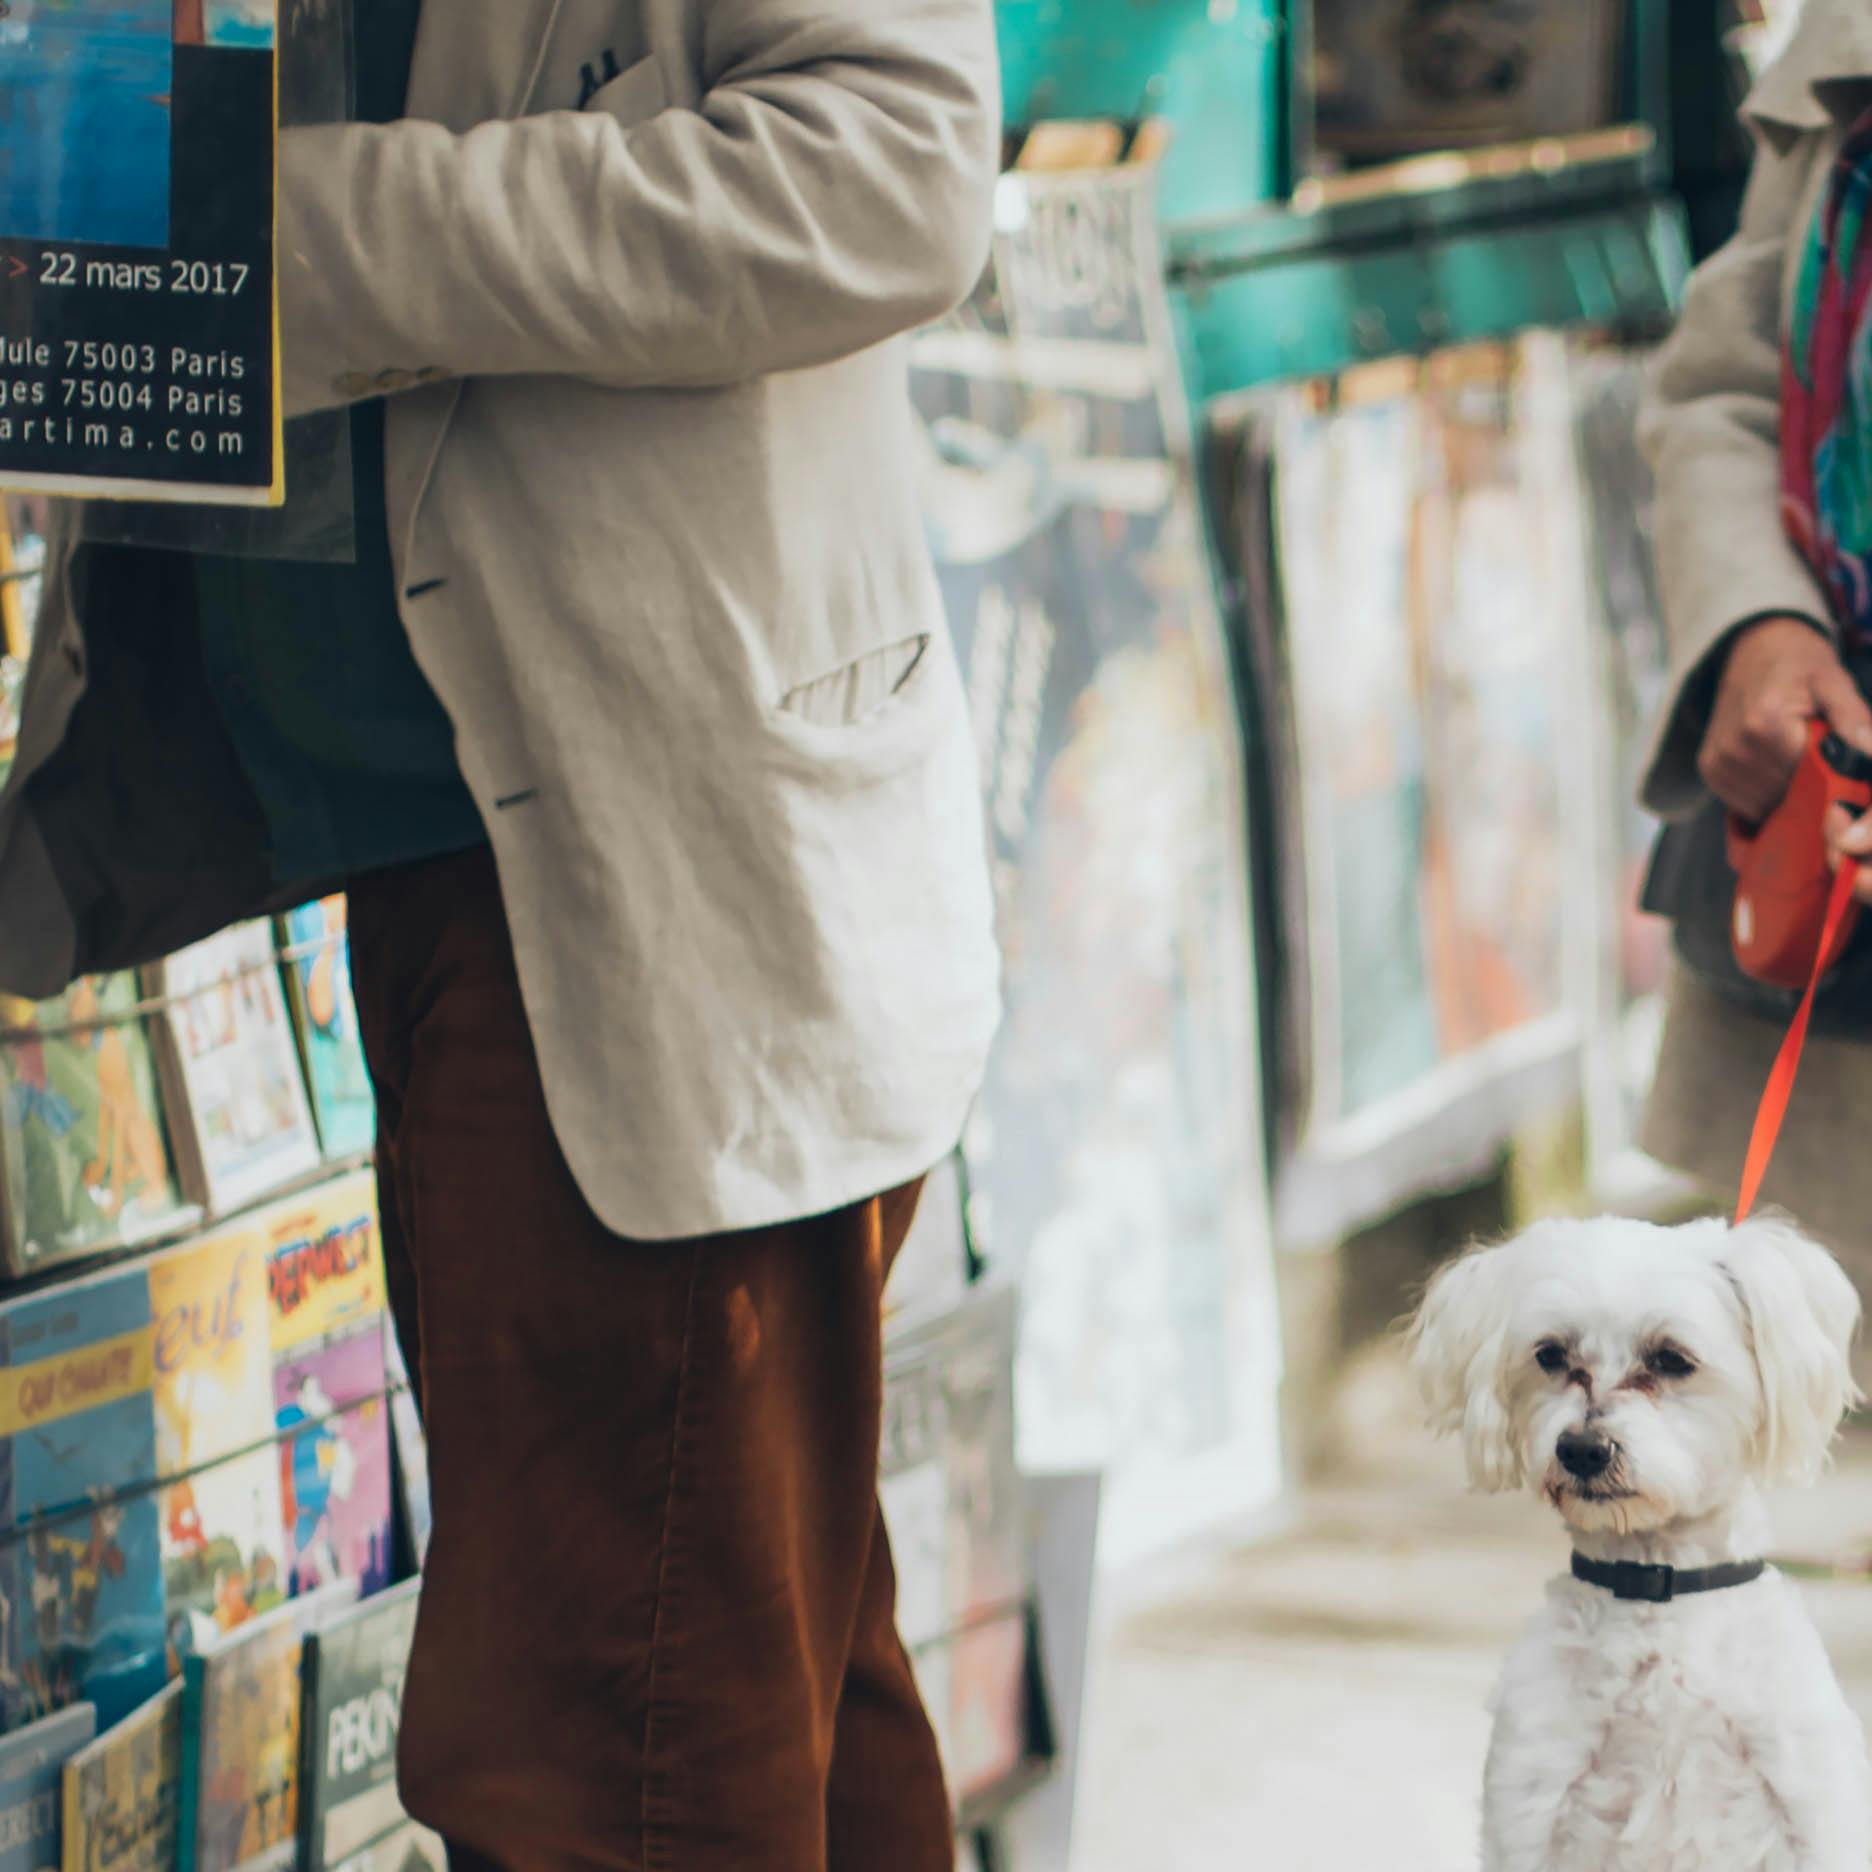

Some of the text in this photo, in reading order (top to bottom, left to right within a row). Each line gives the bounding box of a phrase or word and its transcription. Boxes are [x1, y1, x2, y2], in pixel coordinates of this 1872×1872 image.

[39, 251, 249, 296] 22 mars 2017
[0, 336, 245, 379] ule 75003 Paris
[62, 378, 152, 412] 75004
[168, 385, 243, 417] Paris
